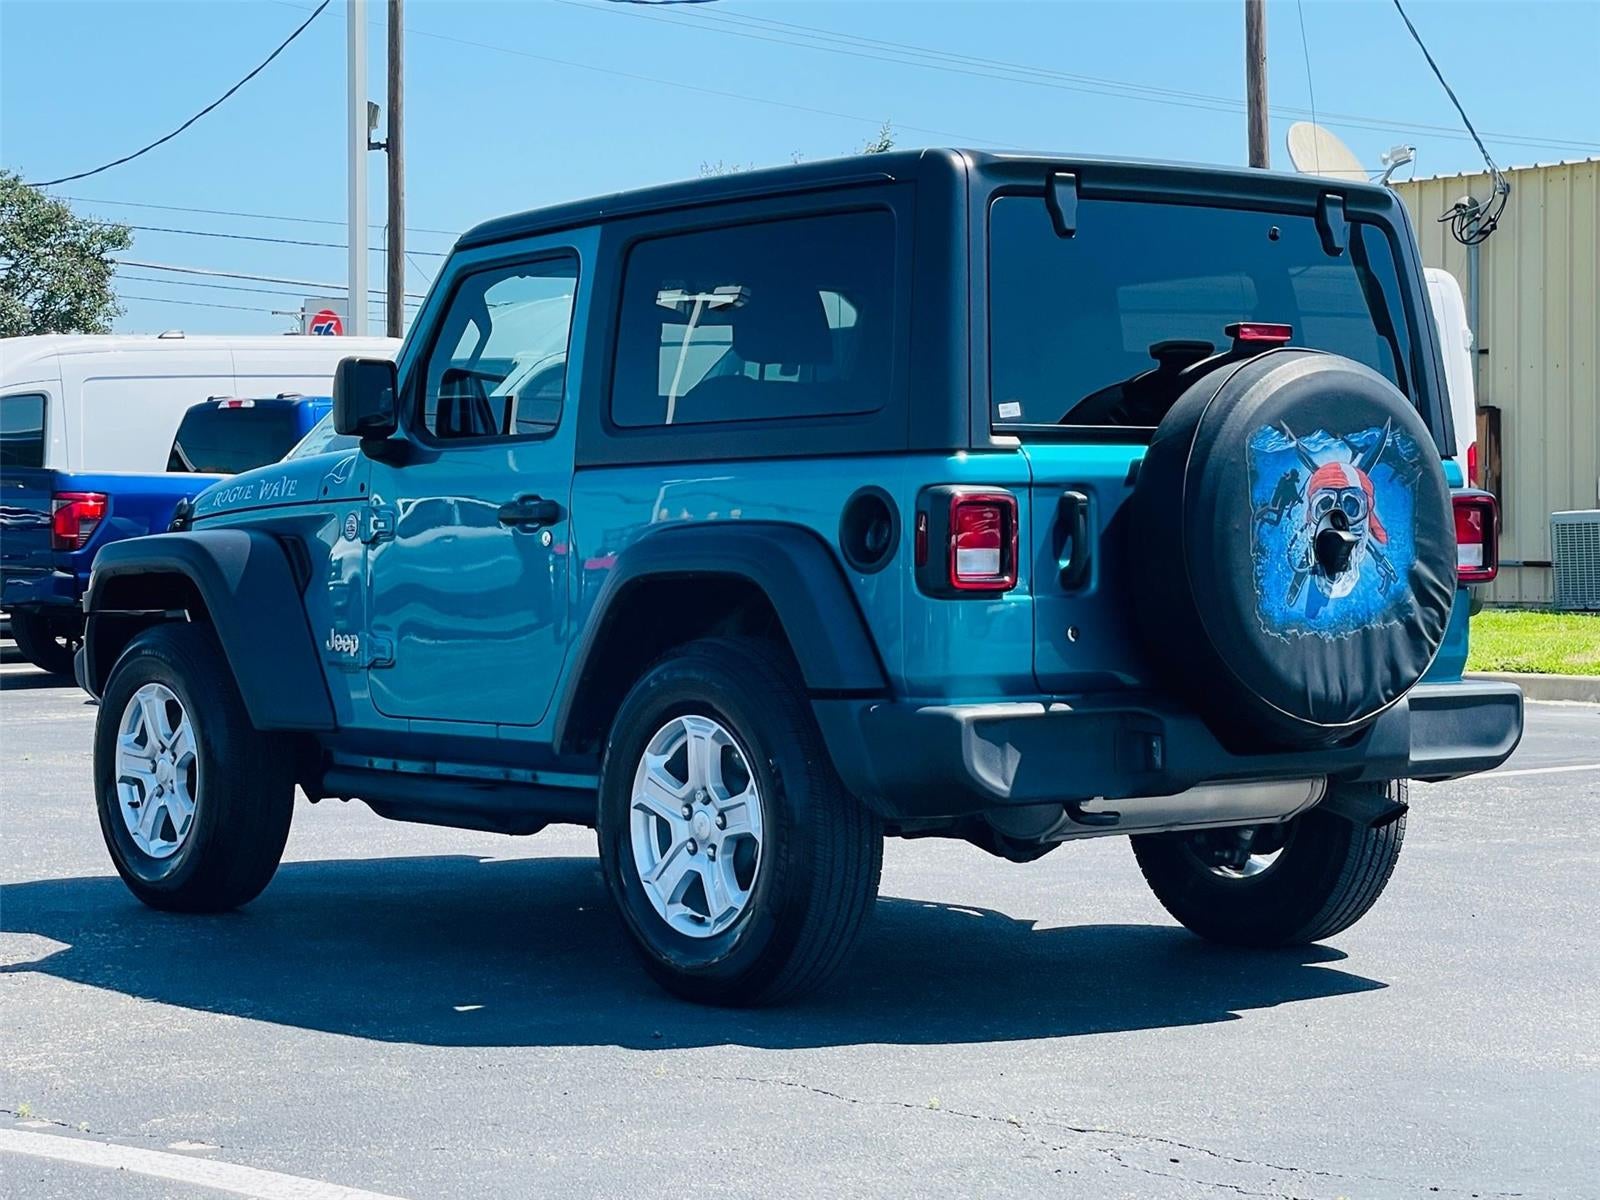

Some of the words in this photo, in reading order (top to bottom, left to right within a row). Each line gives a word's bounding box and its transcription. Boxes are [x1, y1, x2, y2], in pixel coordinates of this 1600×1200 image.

[213, 485, 253, 507] ROGUE
[259, 476, 298, 500] WAVE
[326, 628, 359, 656] Jeep
